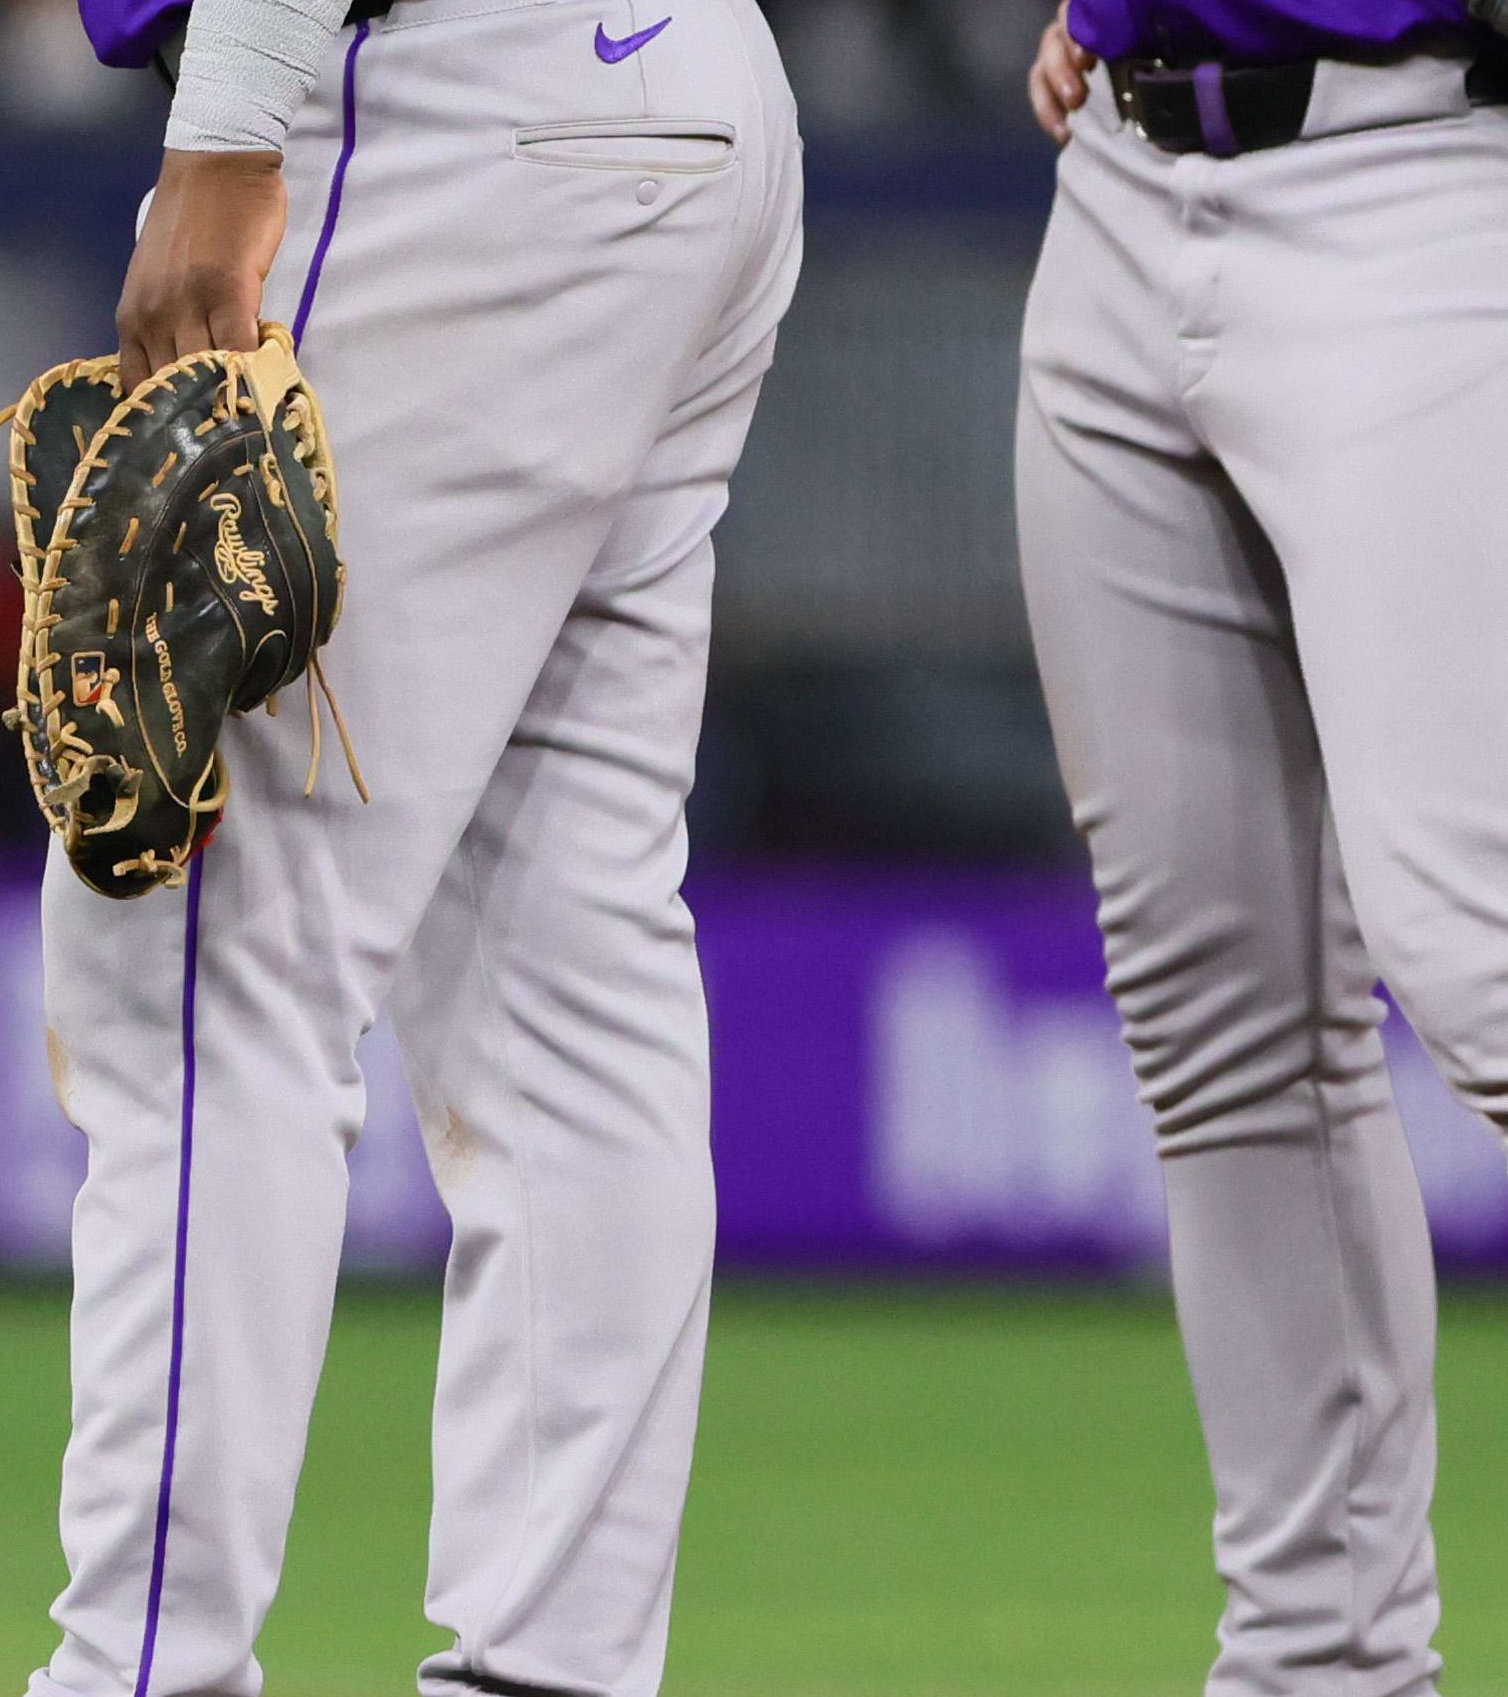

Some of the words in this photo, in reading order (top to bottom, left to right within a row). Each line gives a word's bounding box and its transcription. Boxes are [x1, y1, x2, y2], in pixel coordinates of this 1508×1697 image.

[209, 492, 279, 617] Rawlings
[144, 611, 161, 645] THE
[154, 639, 174, 683] GOLD
[161, 681, 186, 734] GLOVE
